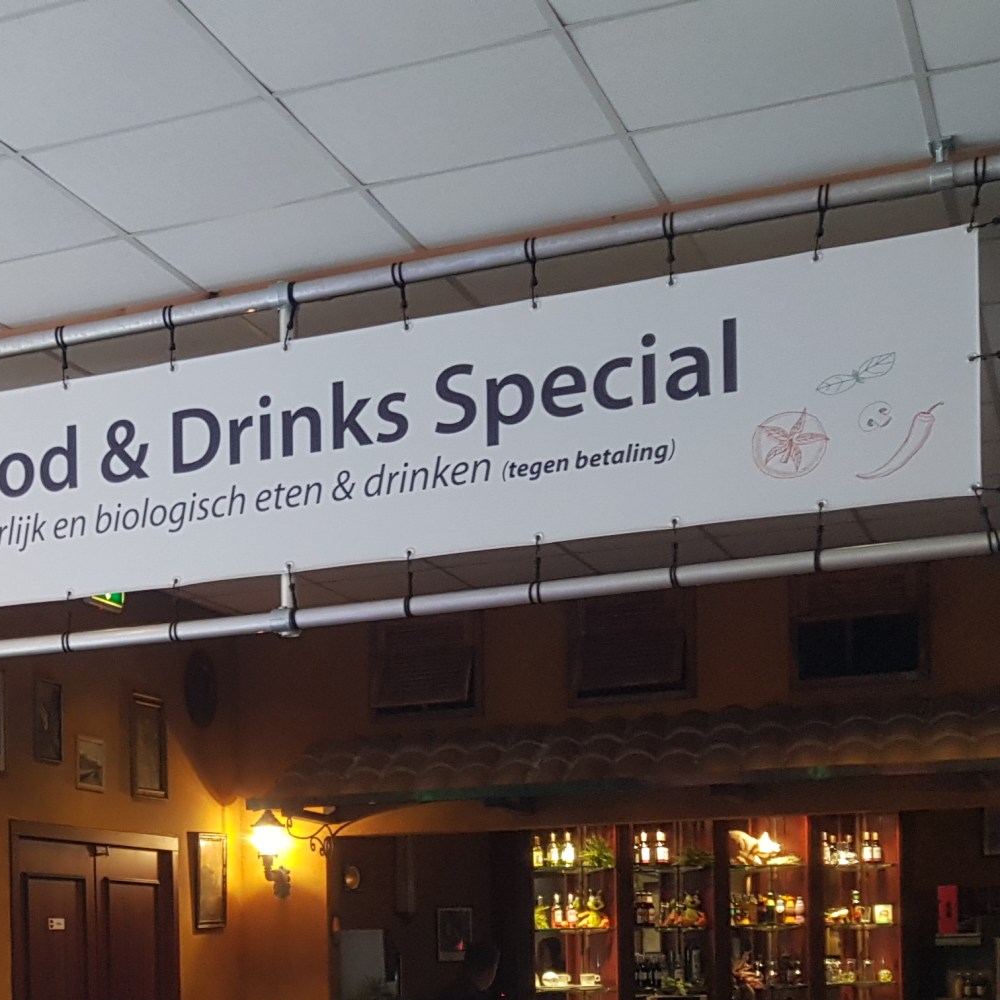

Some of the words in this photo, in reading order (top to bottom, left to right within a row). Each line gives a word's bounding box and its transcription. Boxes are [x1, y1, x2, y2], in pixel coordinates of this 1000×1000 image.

[100, 419, 150, 484] &
[172, 380, 409, 474] Drinks
[434, 317, 738, 447] Special
[53, 514, 87, 540] en
[95, 485, 246, 534] biologisch
[255, 481, 323, 513] eten
[331, 470, 356, 502] &
[363, 455, 492, 498] drinken
[502, 455, 569, 482] (tegen
[575, 438, 676, 471] betaling)
